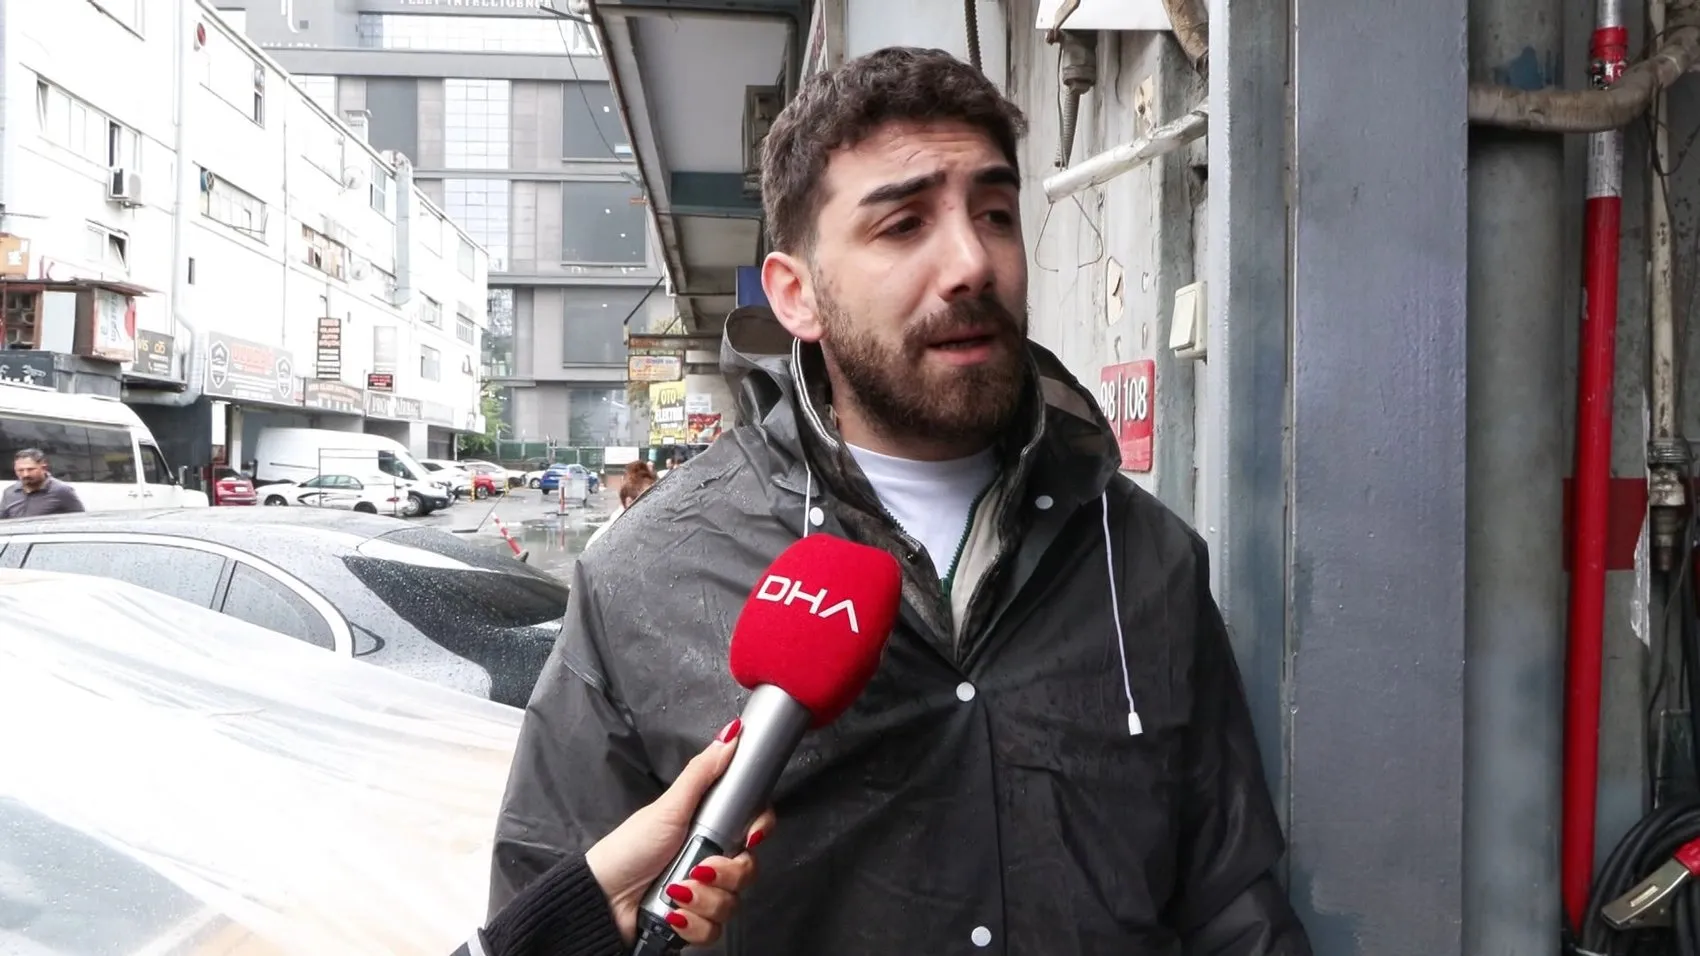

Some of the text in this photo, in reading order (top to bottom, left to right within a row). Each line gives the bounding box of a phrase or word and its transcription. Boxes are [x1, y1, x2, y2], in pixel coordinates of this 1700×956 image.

[660, 389, 677, 406] OTO
[1123, 376, 1147, 421] 108
[756, 574, 860, 634] DHA
